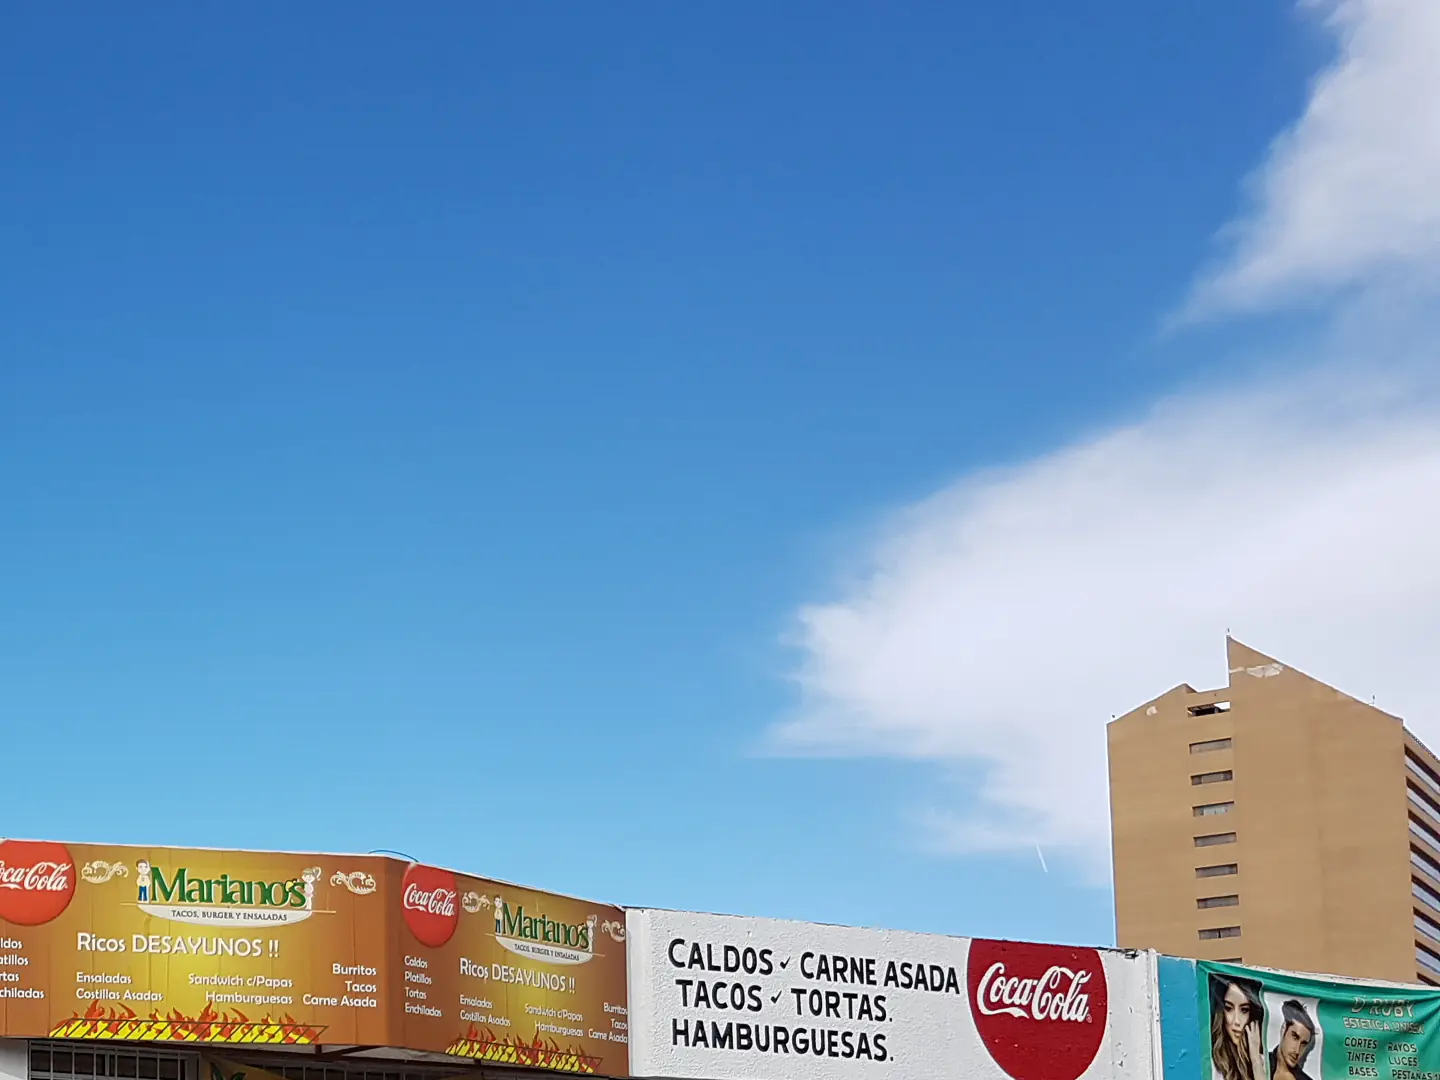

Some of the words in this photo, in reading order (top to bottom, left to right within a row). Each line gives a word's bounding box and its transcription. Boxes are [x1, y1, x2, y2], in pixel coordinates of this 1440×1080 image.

[403, 883, 457, 917] Coca-Cola
[170, 909, 200, 919] TACOS,
[202, 911, 234, 920] BURGER
[235, 912, 242, 920] Y
[243, 912, 288, 922] ENSALADAS
[76, 932, 127, 953] Ricos
[132, 934, 263, 958] DESAYUNOS
[404, 956, 428, 969] Caldos
[668, 938, 773, 976] CALDOS
[800, 951, 877, 987] CARNE
[883, 961, 960, 995] ASADA
[332, 963, 377, 977] Burritos
[460, 958, 489, 978] Ricos
[492, 964, 566, 992] DESAYUNOS
[76, 972, 132, 984] Ensaladas
[188, 974, 244, 987] Sandwich
[246, 975, 293, 990] c/Papas
[404, 972, 432, 985] Platillos
[344, 981, 377, 993] Tacos
[404, 987, 427, 1000] Tortas
[977, 961, 1093, 1023] Coca-Cola
[76, 988, 121, 1001] Costillas
[123, 988, 163, 1002] Asadas
[205, 991, 293, 1006] Hamburguesas
[303, 994, 337, 1007] Carne
[340, 995, 377, 1008] Asada
[460, 995, 493, 1009] Ensaladas
[675, 979, 761, 1013] TACOS
[791, 987, 893, 1023] TORTAS.
[404, 1003, 442, 1017] Enchiladas
[524, 1004, 556, 1018] Sandwich
[460, 1010, 487, 1023] Costillas
[488, 1013, 511, 1027] Asadas
[534, 1021, 584, 1037] Hamburguesas
[672, 1018, 895, 1063] HAMBURGUESAS.
[1344, 1037, 1377, 1049] CORTES
[1388, 1042, 1417, 1053] RAYOS
[1347, 1051, 1375, 1063] TINTES
[1388, 1056, 1418, 1067] LUCES
[1348, 1066, 1378, 1077] BASES
